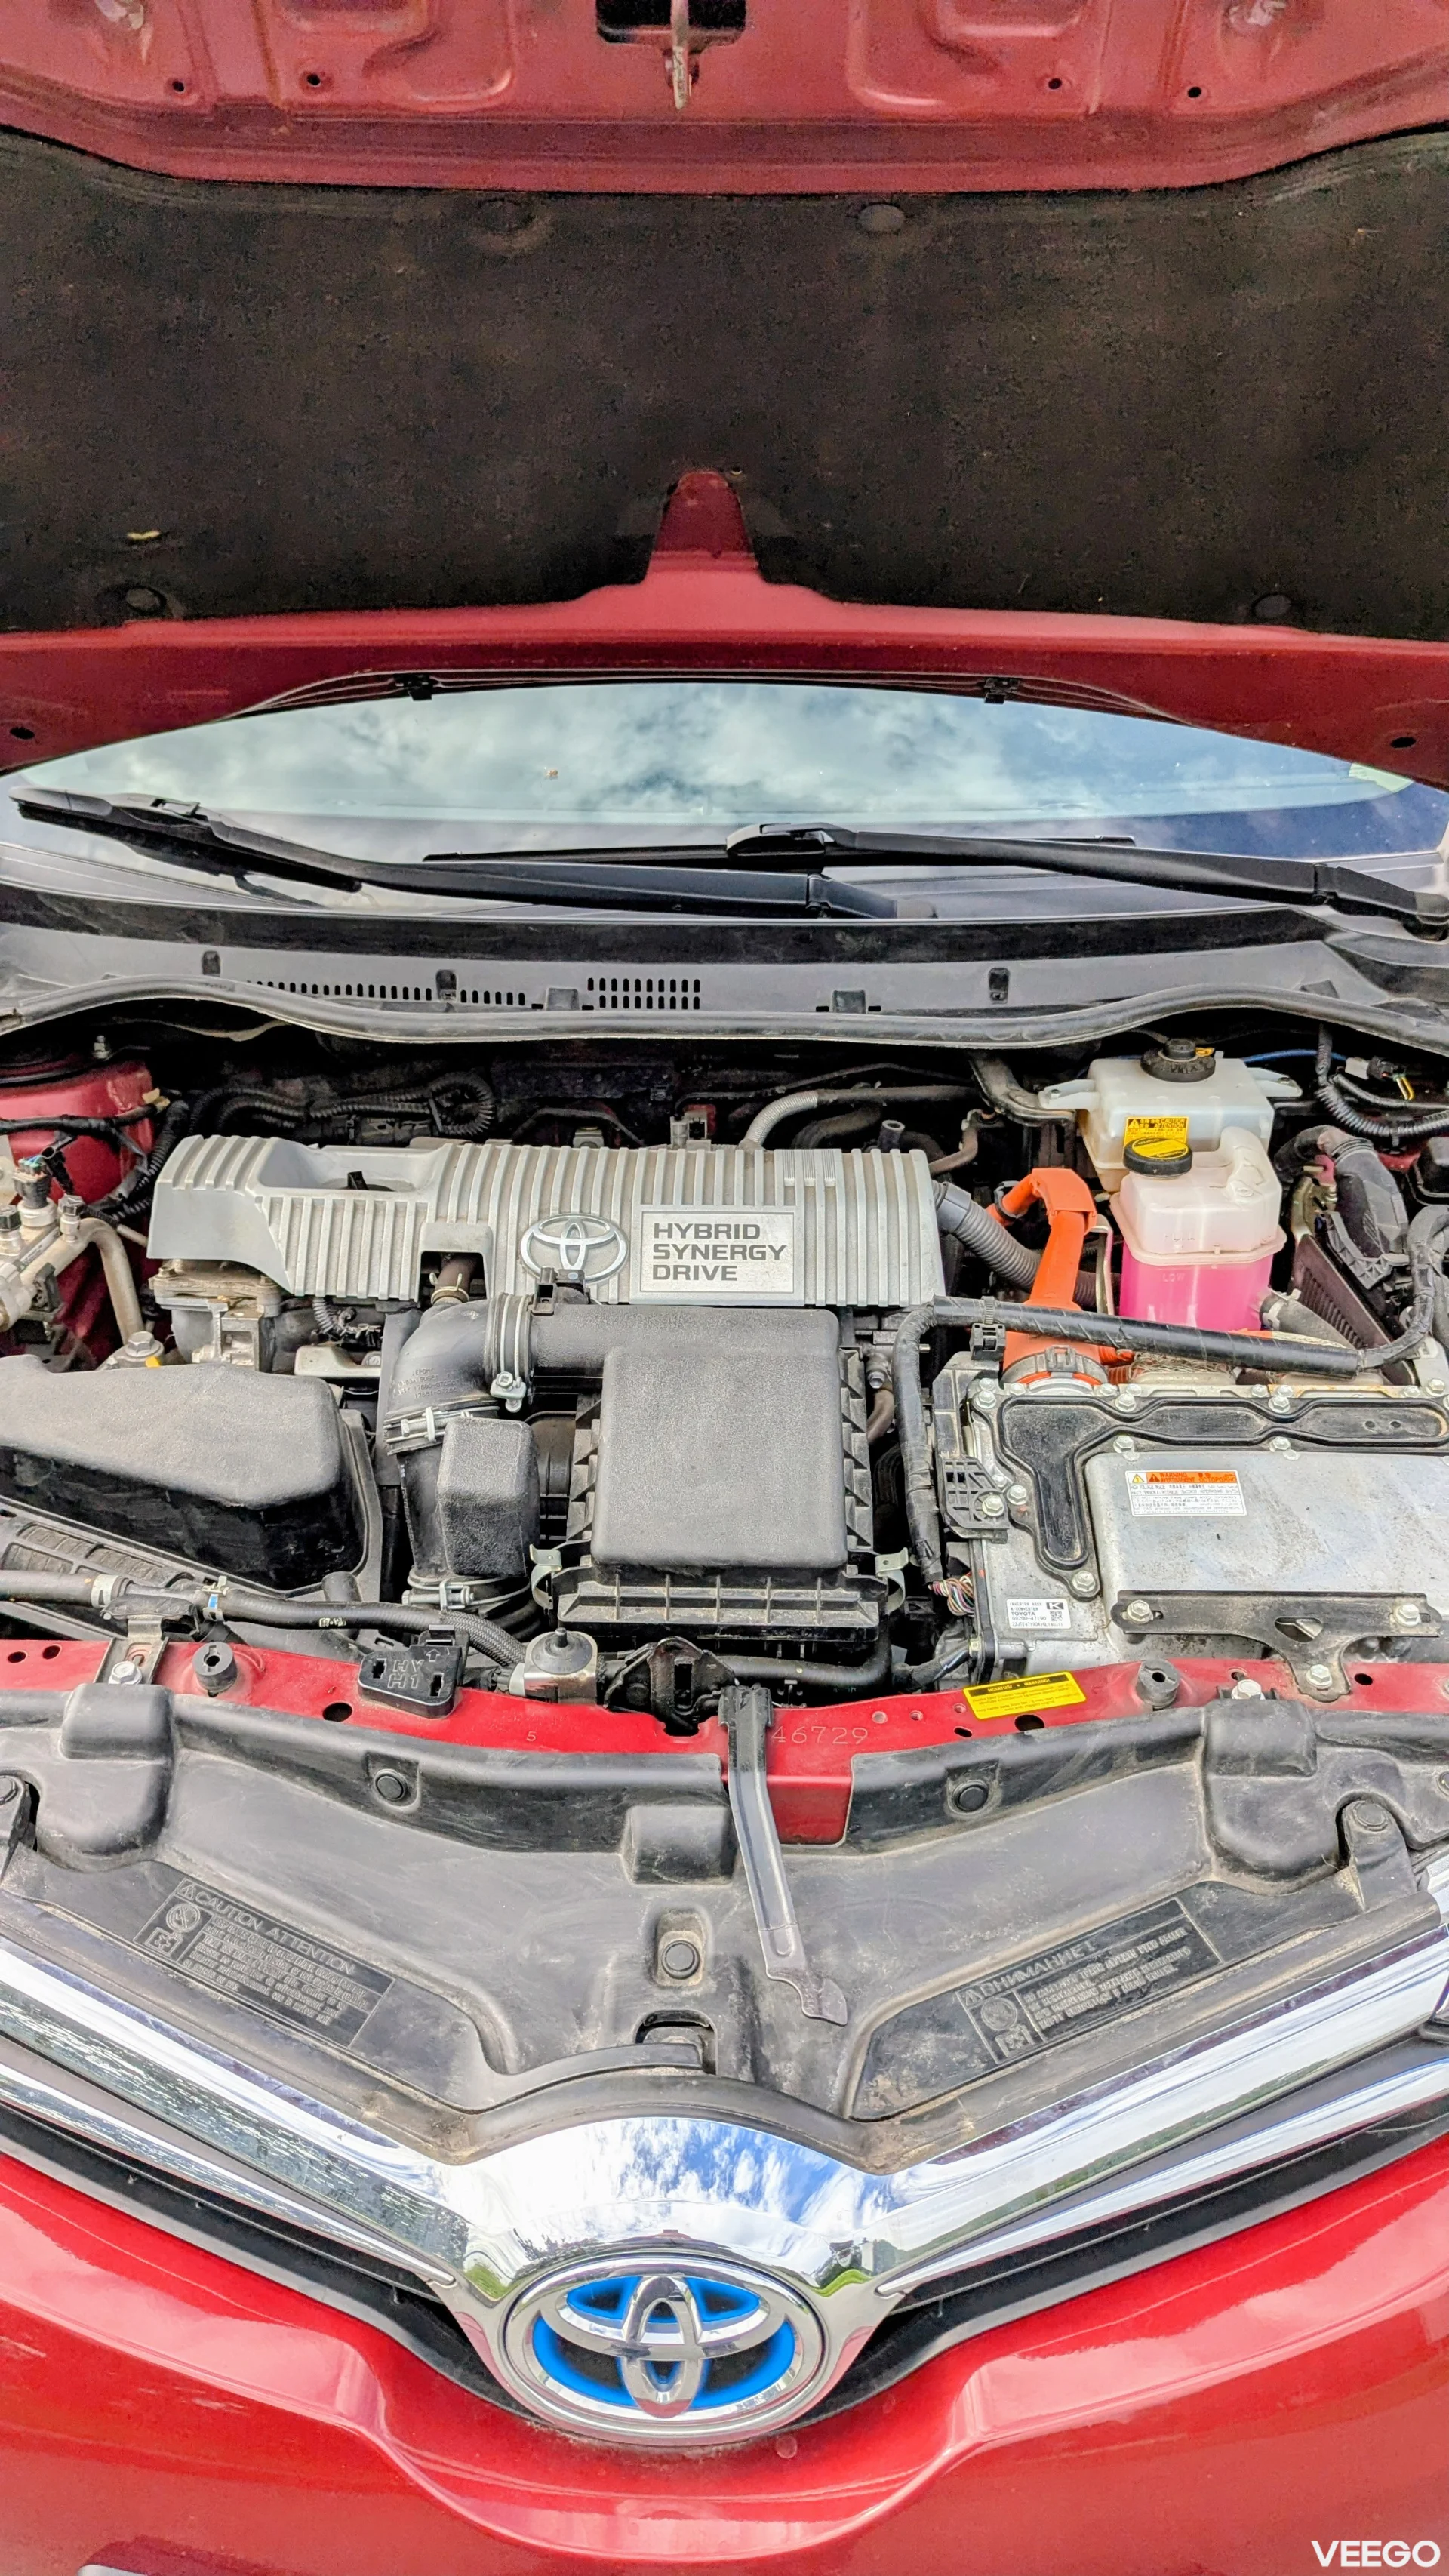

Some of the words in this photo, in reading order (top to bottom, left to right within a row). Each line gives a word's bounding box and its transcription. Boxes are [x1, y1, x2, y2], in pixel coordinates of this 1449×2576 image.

[654, 1223, 761, 1239] HYBRID
[653, 1243, 788, 1261] SYNERGY
[653, 1264, 738, 1281] DRIVE
[1162, 1273, 1185, 1282] LOW
[526, 1731, 537, 1741] 5
[771, 1725, 868, 1745] 46729
[195, 1891, 263, 1931] CAUTION
[265, 1927, 355, 1976] ATTENTION
